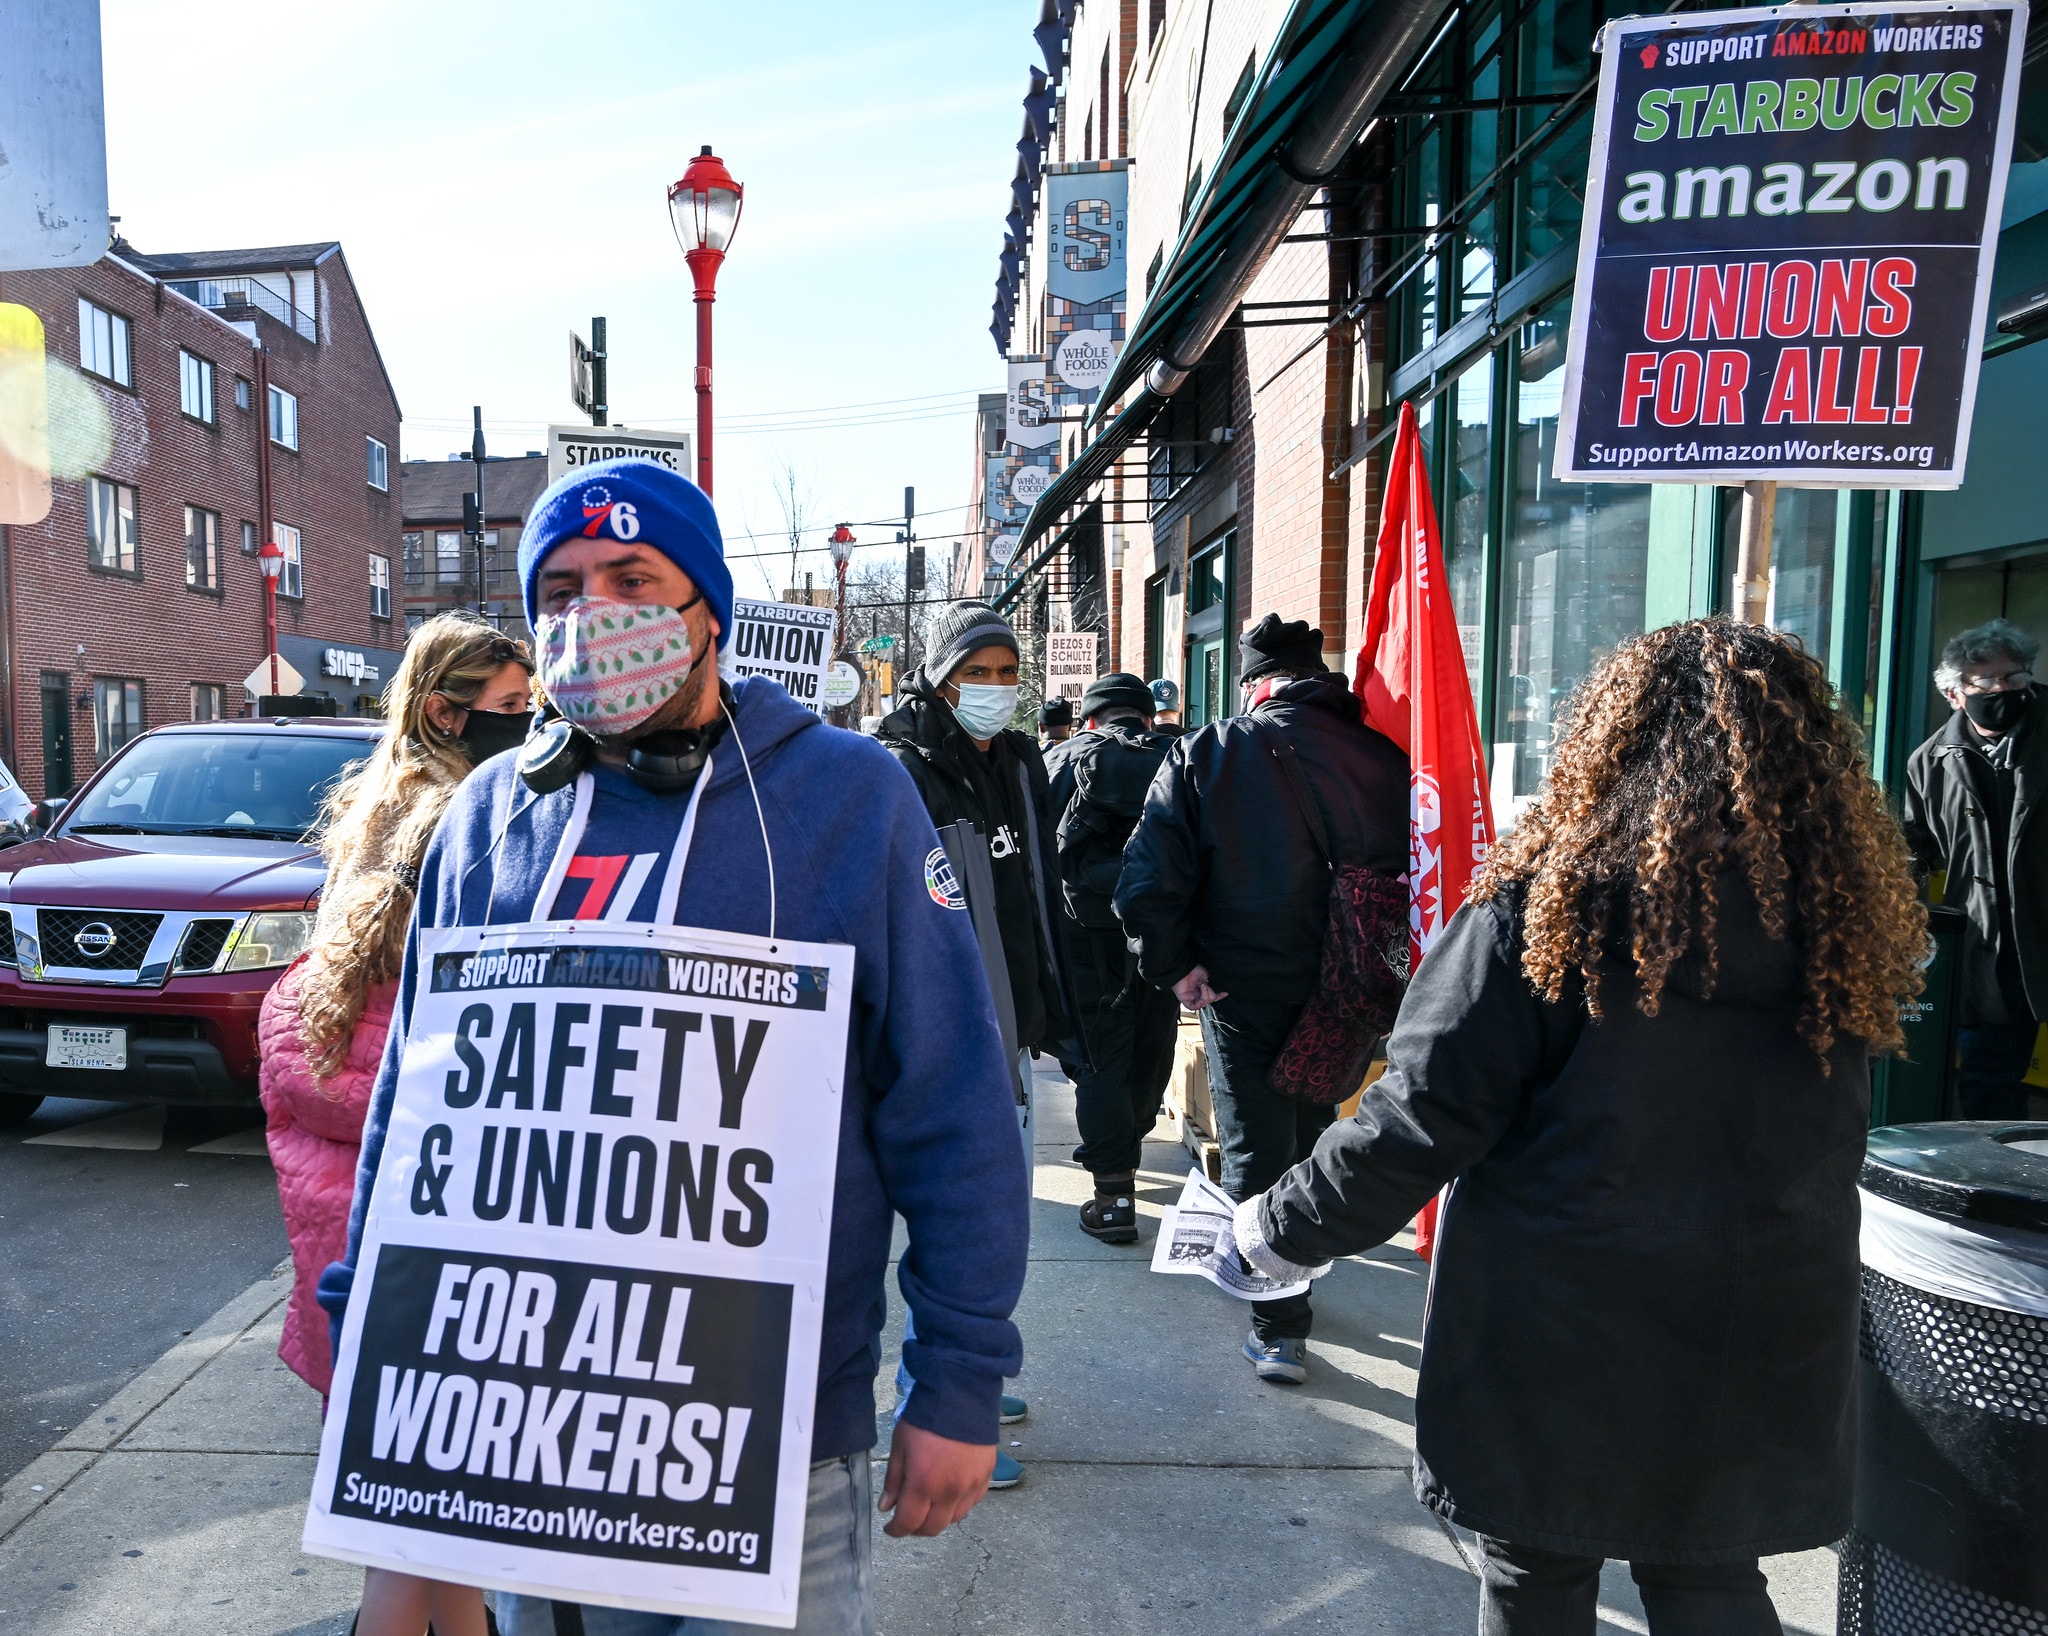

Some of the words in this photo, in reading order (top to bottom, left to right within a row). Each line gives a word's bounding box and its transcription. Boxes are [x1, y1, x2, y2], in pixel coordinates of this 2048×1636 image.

[1666, 34, 1767, 66] SUPPORT
[1771, 29, 1867, 56] AMAZON
[1873, 25, 1982, 53] WORKERS
[1634, 72, 1977, 142] STARBUCKS
[1617, 156, 1969, 223] amazon
[1643, 256, 1916, 343] UNIONS
[1063, 346, 1109, 359] WHOLE
[1065, 359, 1108, 371] FOODS
[1618, 349, 1750, 427] FOR
[1762, 346, 1923, 425] ALL!
[1588, 440, 1934, 467] SupportAmazonWorkers.org
[1016, 477, 1047, 485] WHOLE
[582, 501, 640, 540] 76
[735, 604, 832, 626] STARBUCKS:
[735, 621, 824, 667] UNION
[1051, 650, 1092, 662] SCHULTZ
[1052, 638, 1083, 650] BEZOS
[1086, 638, 1092, 649] &
[1050, 664, 1082, 676] BILLIONAIRE
[1060, 683, 1083, 699] UNION
[78, 935, 110, 943] NISSAN
[459, 952, 550, 989] SUPPORT
[553, 949, 659, 988] AMAZON
[667, 956, 799, 1005] WORKERS
[1899, 1013, 1922, 1022] IPES
[444, 1002, 770, 1130] SAFETY
[410, 1123, 454, 1217] &
[472, 1125, 774, 1247] UNIONS
[422, 1262, 557, 1367] FOR
[559, 1278, 694, 1384] ALL
[371, 1365, 753, 1505] WORKERS!
[342, 1472, 760, 1564] SupportAmazonWorkers.org
